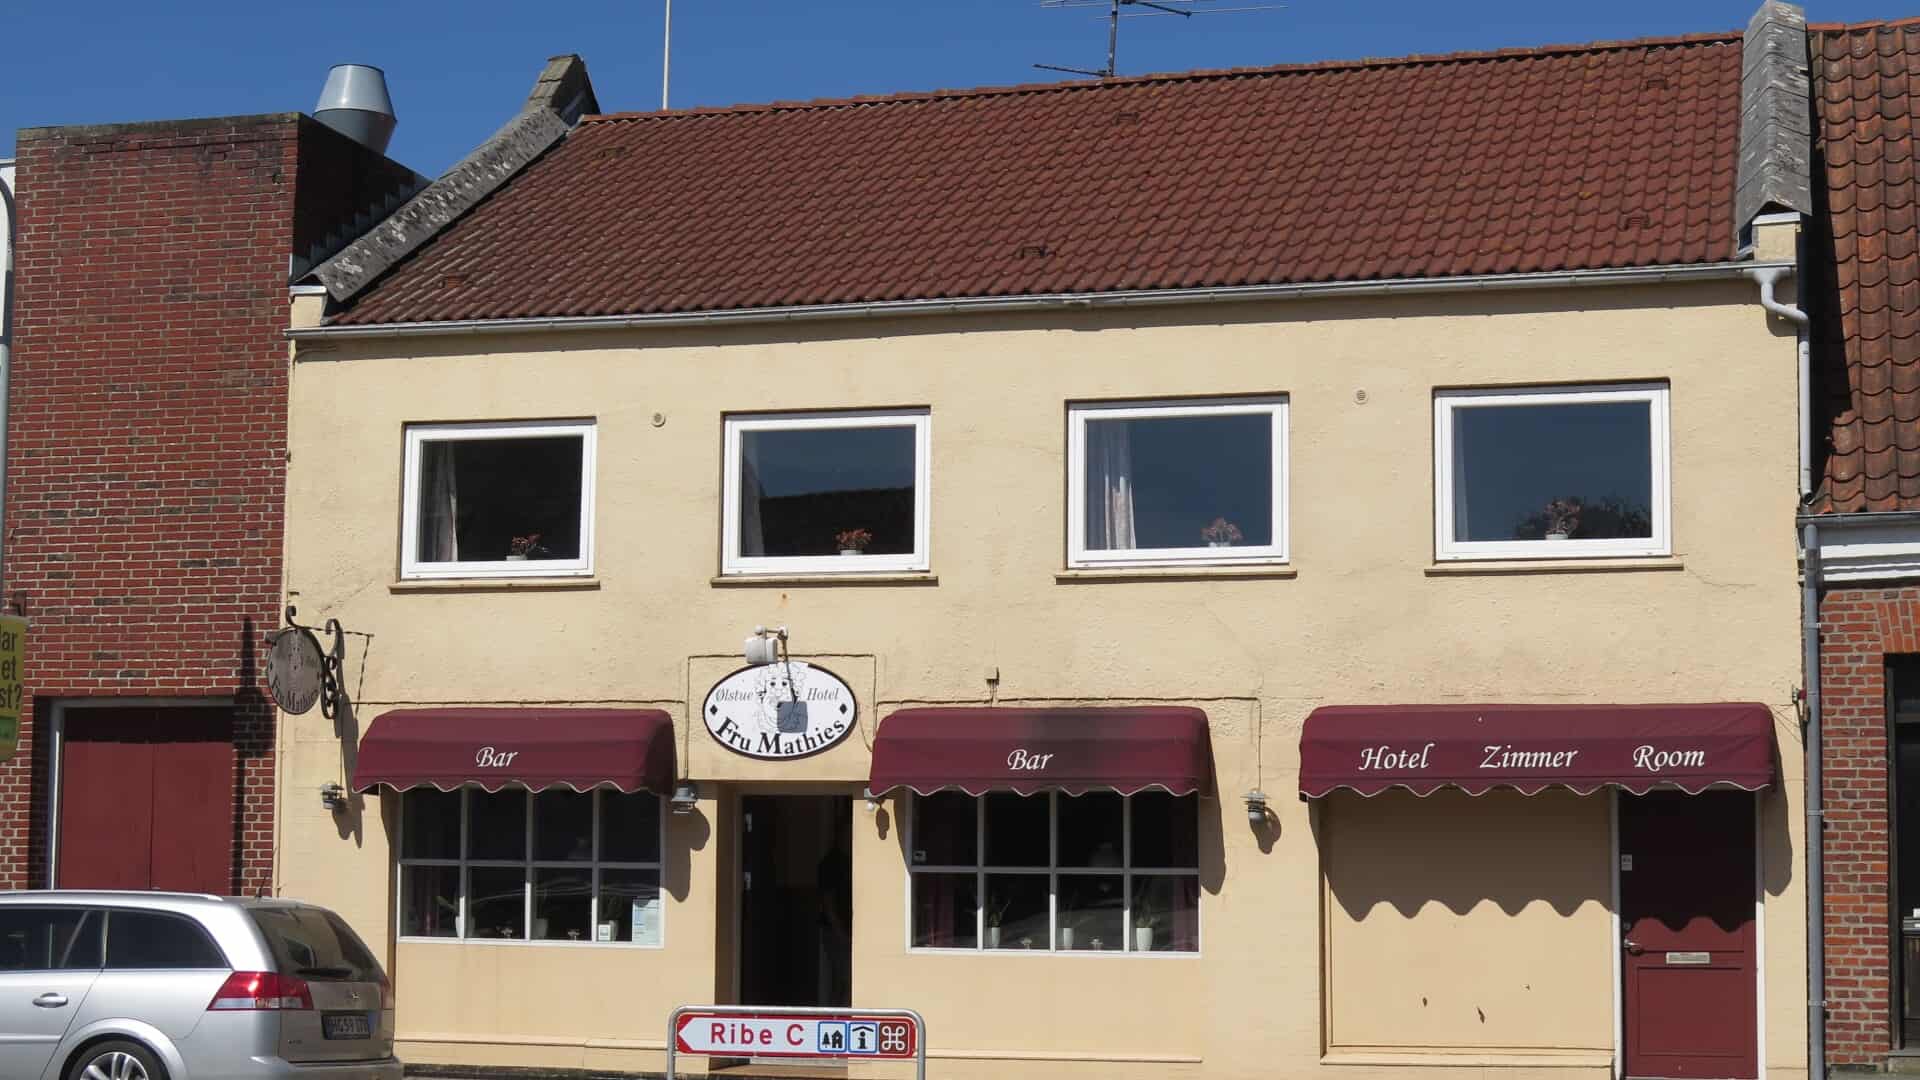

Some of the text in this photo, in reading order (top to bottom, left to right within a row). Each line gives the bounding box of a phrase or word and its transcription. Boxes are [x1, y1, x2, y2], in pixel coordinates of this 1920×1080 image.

[0, 627, 17, 651] ar
[715, 686, 754, 702] Ølstue
[807, 687, 839, 702] Hotel
[716, 716, 845, 754] Fru Mathies
[475, 746, 519, 768] Bar
[1007, 748, 1054, 770] Bar
[1358, 742, 1705, 772] Hotel Zimmer Room
[710, 1022, 805, 1046] Ribe C
